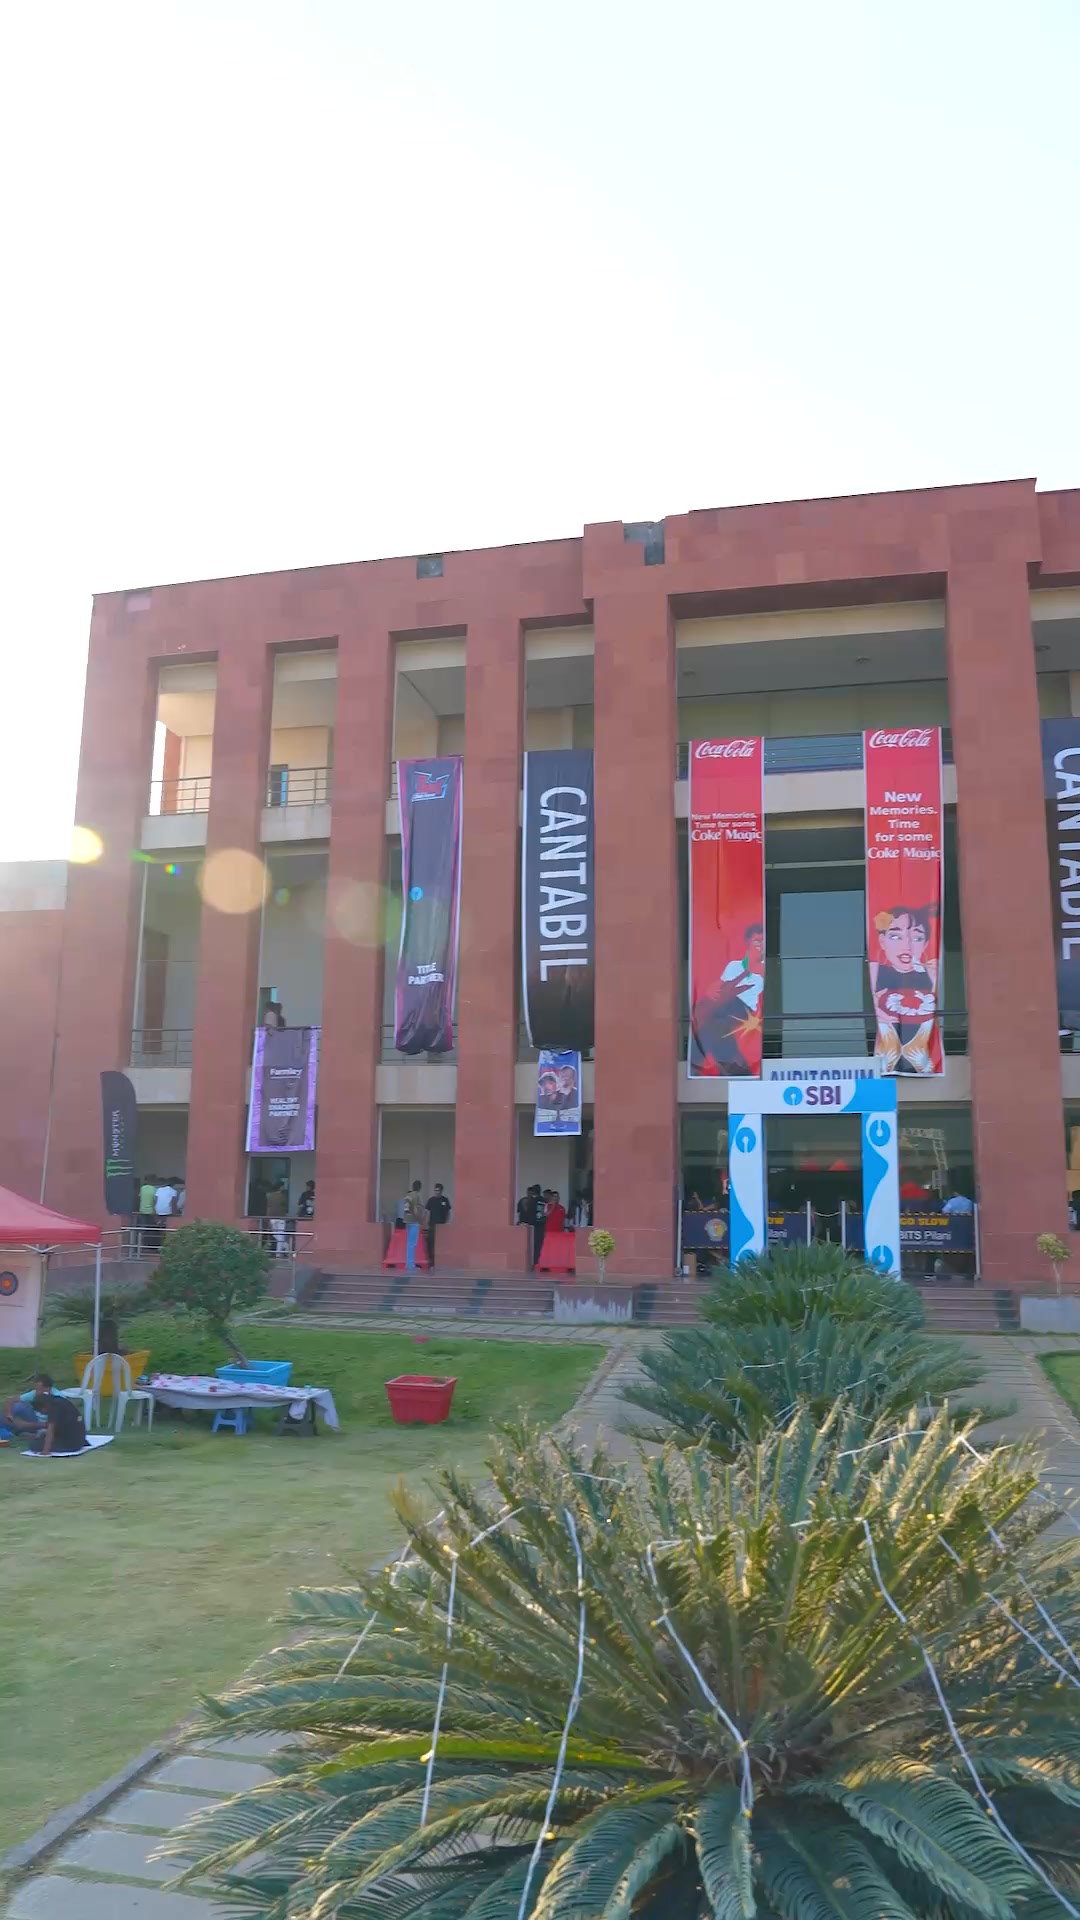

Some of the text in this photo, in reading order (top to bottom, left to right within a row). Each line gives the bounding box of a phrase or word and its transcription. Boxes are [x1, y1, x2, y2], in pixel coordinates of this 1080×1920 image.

[869, 729, 934, 749] Coca-Cola
[695, 740, 757, 758] Coca-Cola
[884, 792, 922, 802] New
[869, 805, 938, 815] Memories.
[695, 821, 716, 829] Time
[732, 820, 756, 828] some
[888, 819, 920, 828] Time
[691, 828, 762, 842] Coke Magic
[875, 832, 933, 842] for some
[868, 846, 941, 861] Coke Magic
[540, 786, 588, 982] CANTABIL
[416, 962, 437, 975] TITLE
[806, 1086, 841, 1106] SBI
[900, 1217, 949, 1225] GO SLOW
[924, 1230, 952, 1240] Pilani
